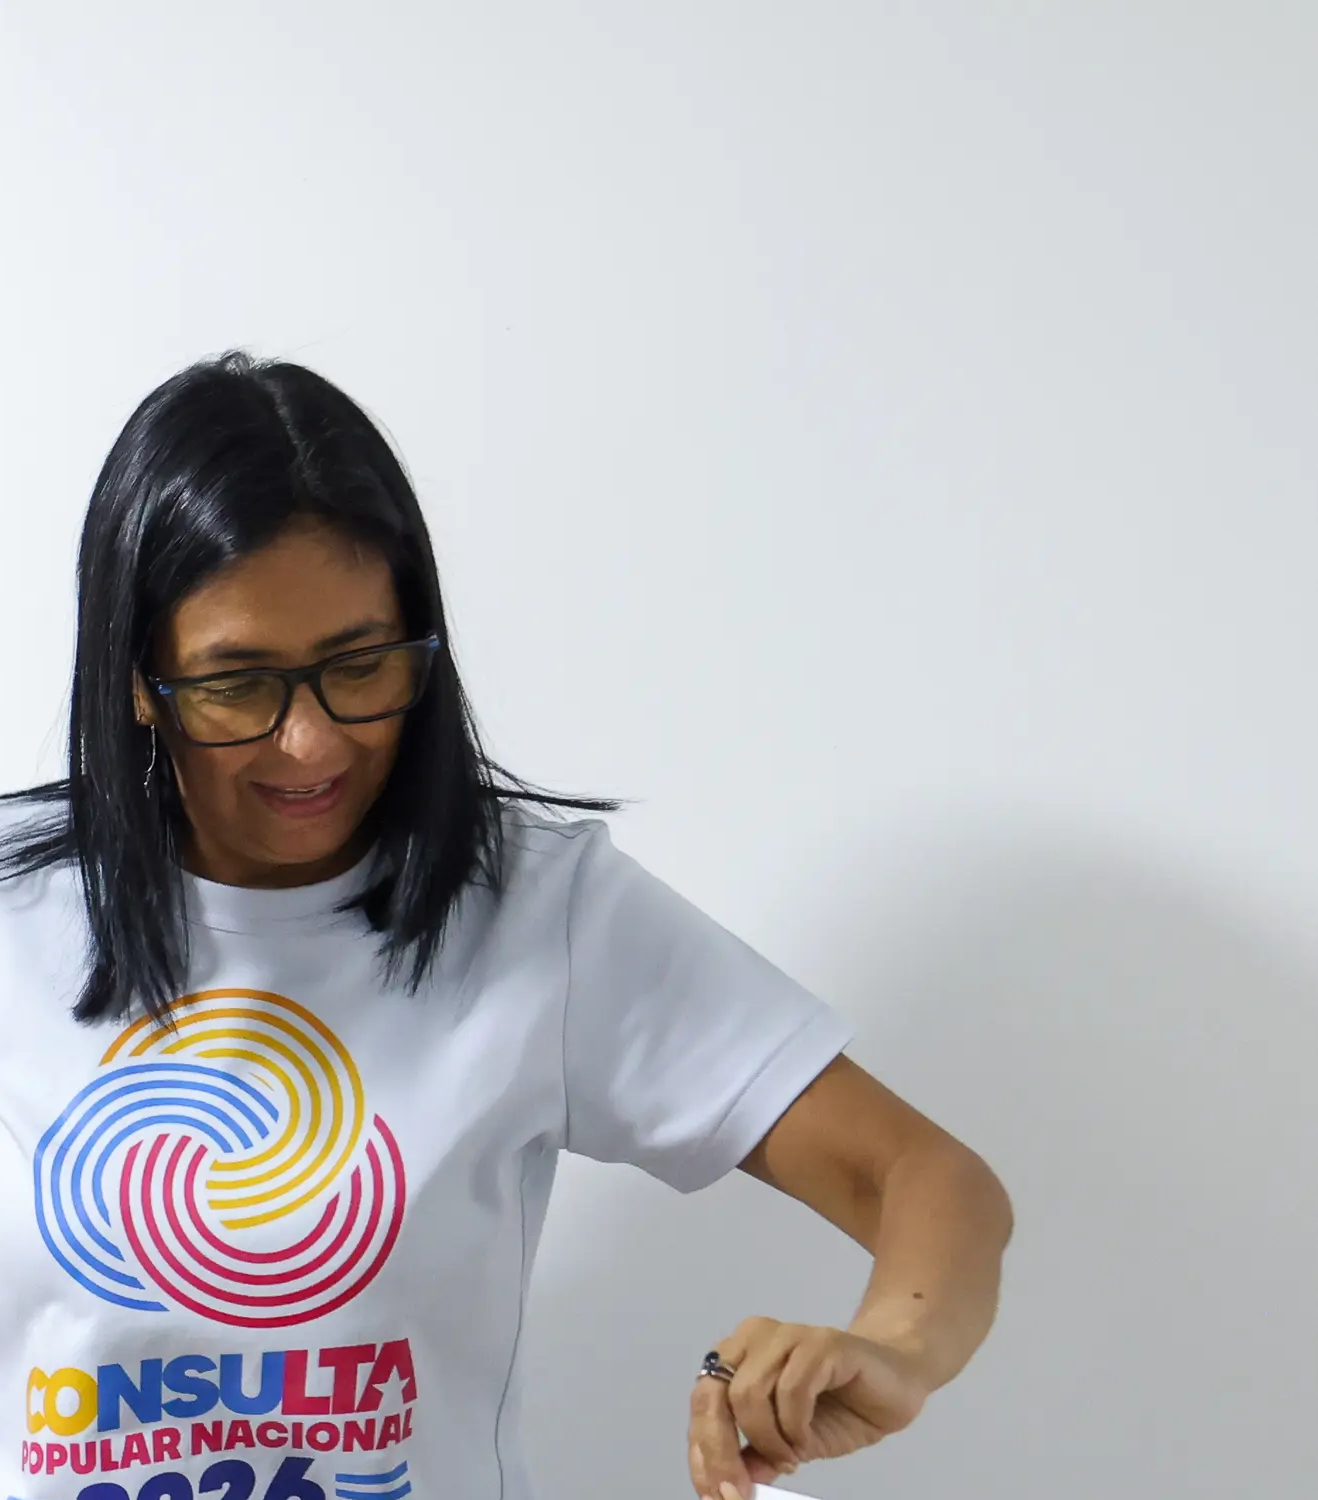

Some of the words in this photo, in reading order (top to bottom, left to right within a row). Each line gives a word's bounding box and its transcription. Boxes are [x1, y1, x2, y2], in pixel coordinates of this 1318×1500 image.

[26, 1339, 417, 1435] CONSULTA
[22, 1427, 182, 1474] POPULAR
[191, 1408, 414, 1454] NACIONAL
